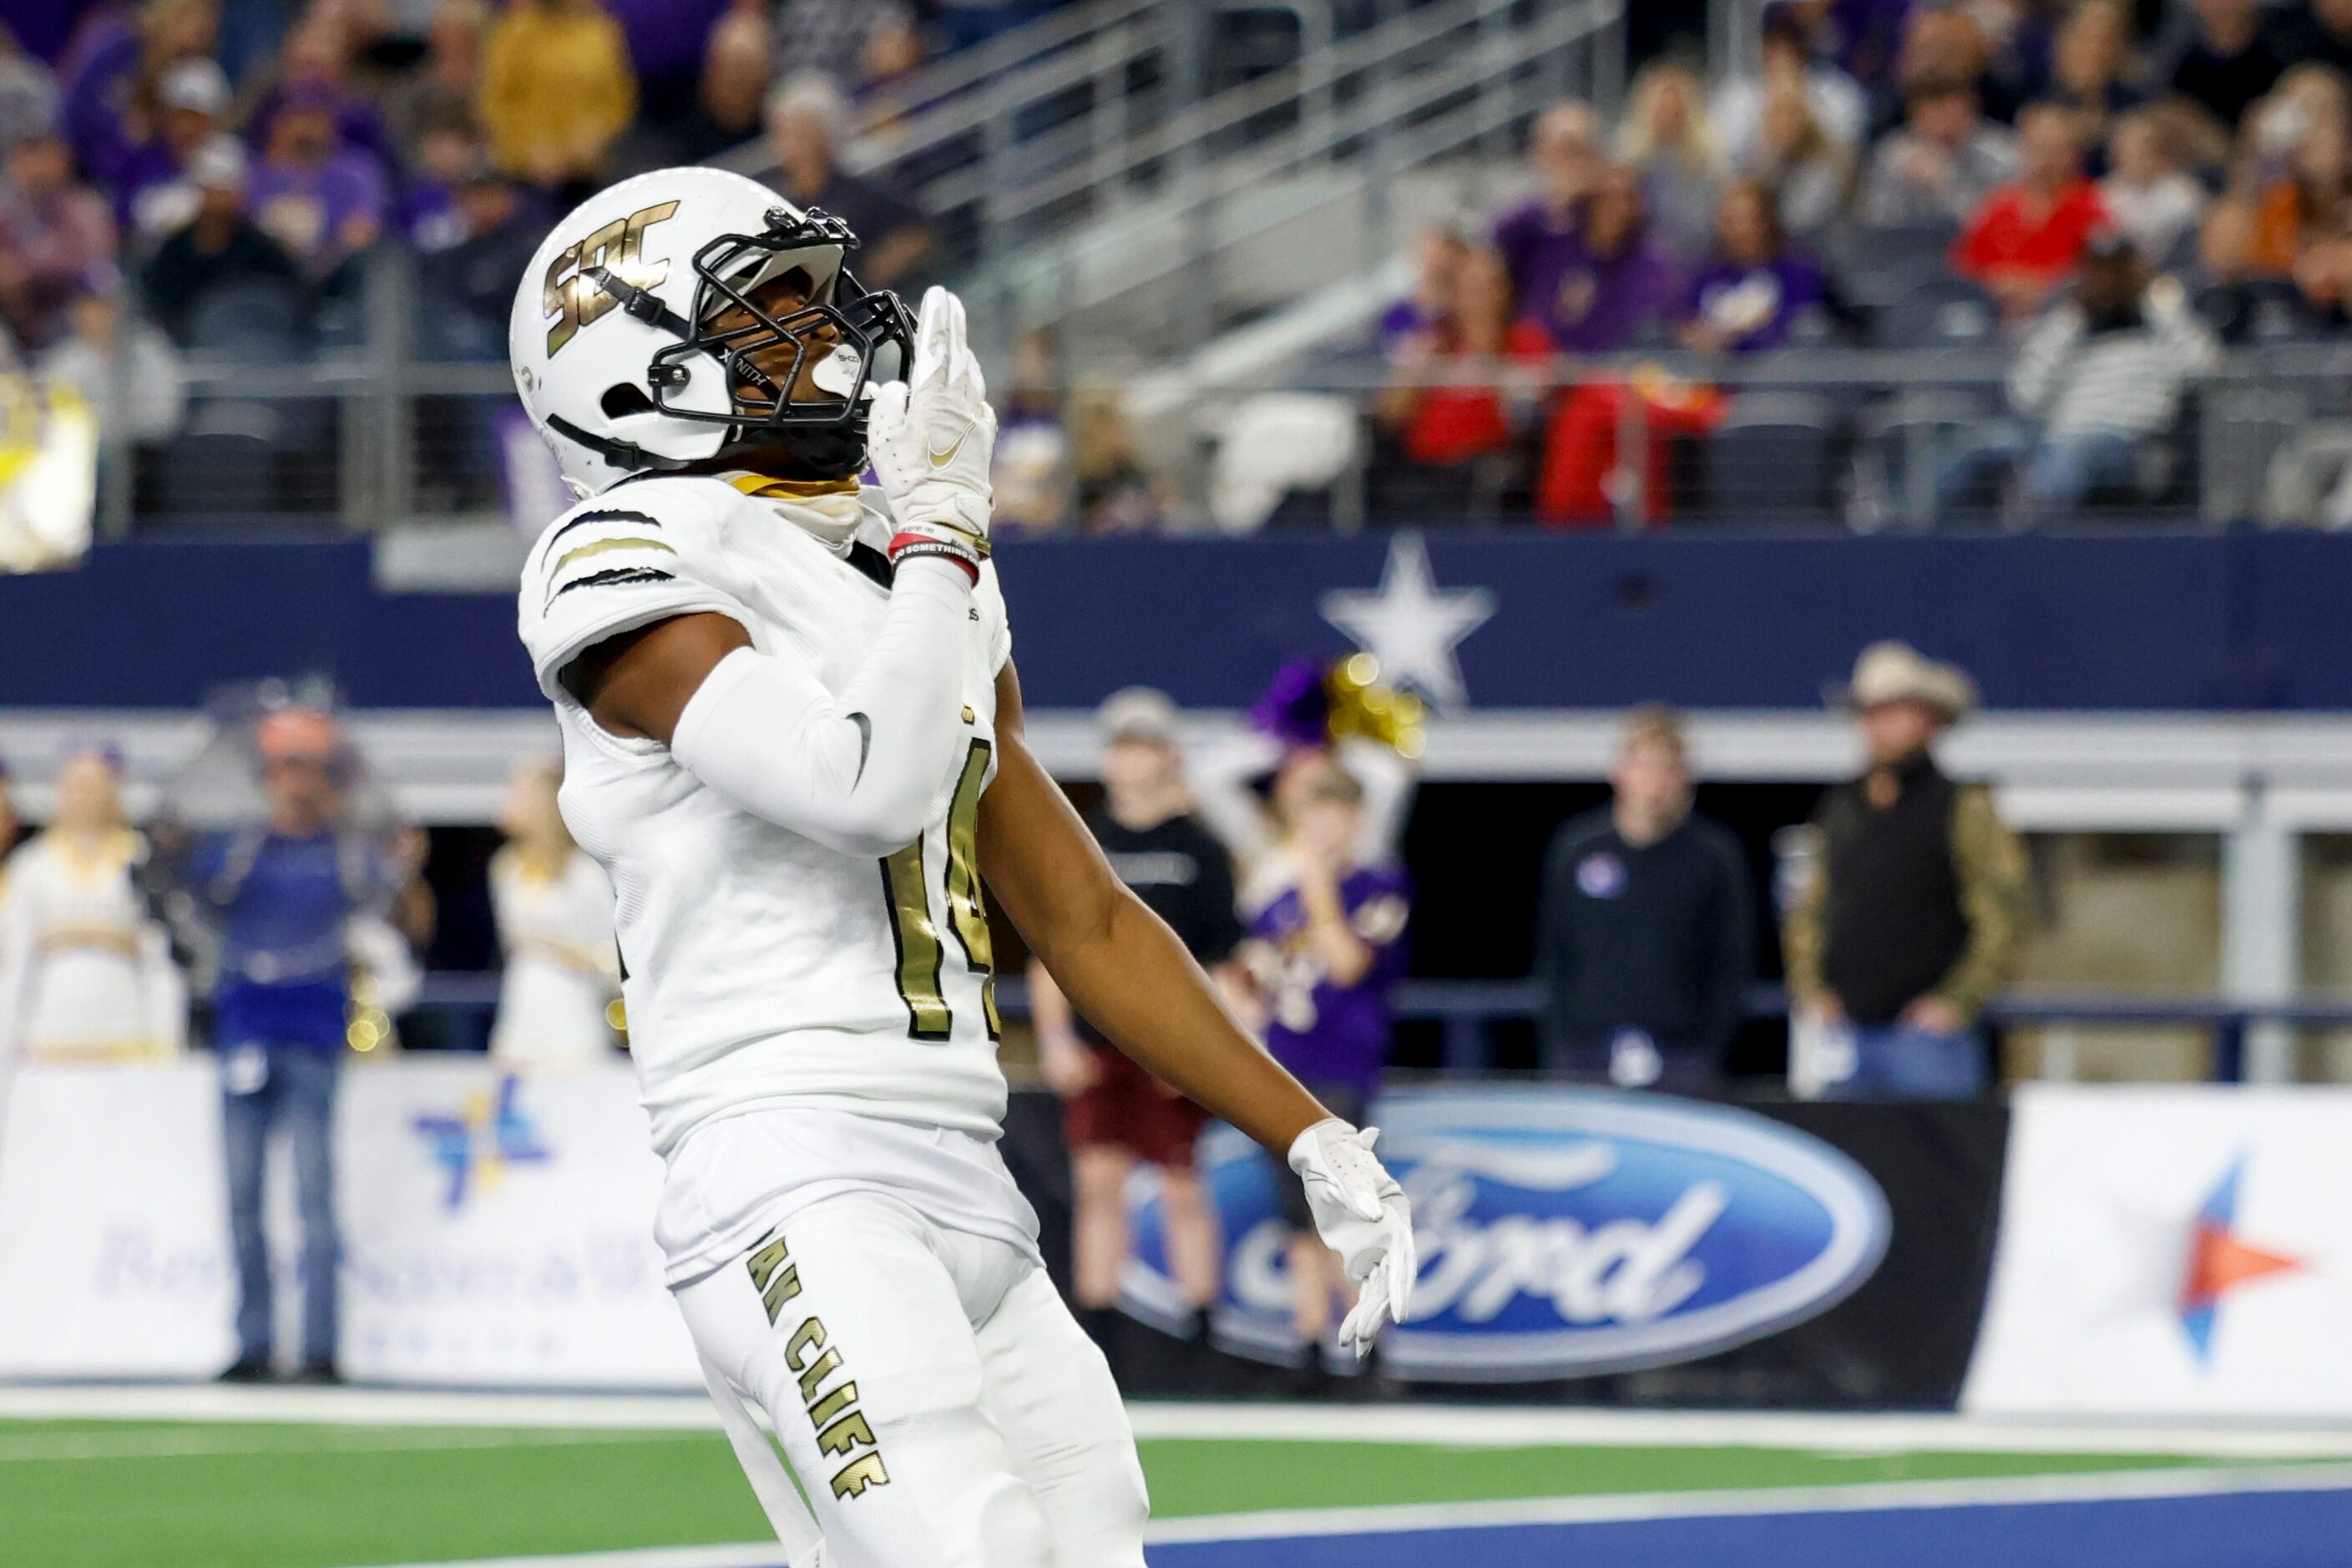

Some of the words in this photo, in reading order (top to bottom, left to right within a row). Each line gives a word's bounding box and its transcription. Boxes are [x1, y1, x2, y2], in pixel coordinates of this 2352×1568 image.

[718, 347, 767, 387] XNITH
[906, 543, 969, 559] SOMETHING
[745, 1227, 803, 1329] AK
[784, 1315, 891, 1502] CLIFF
